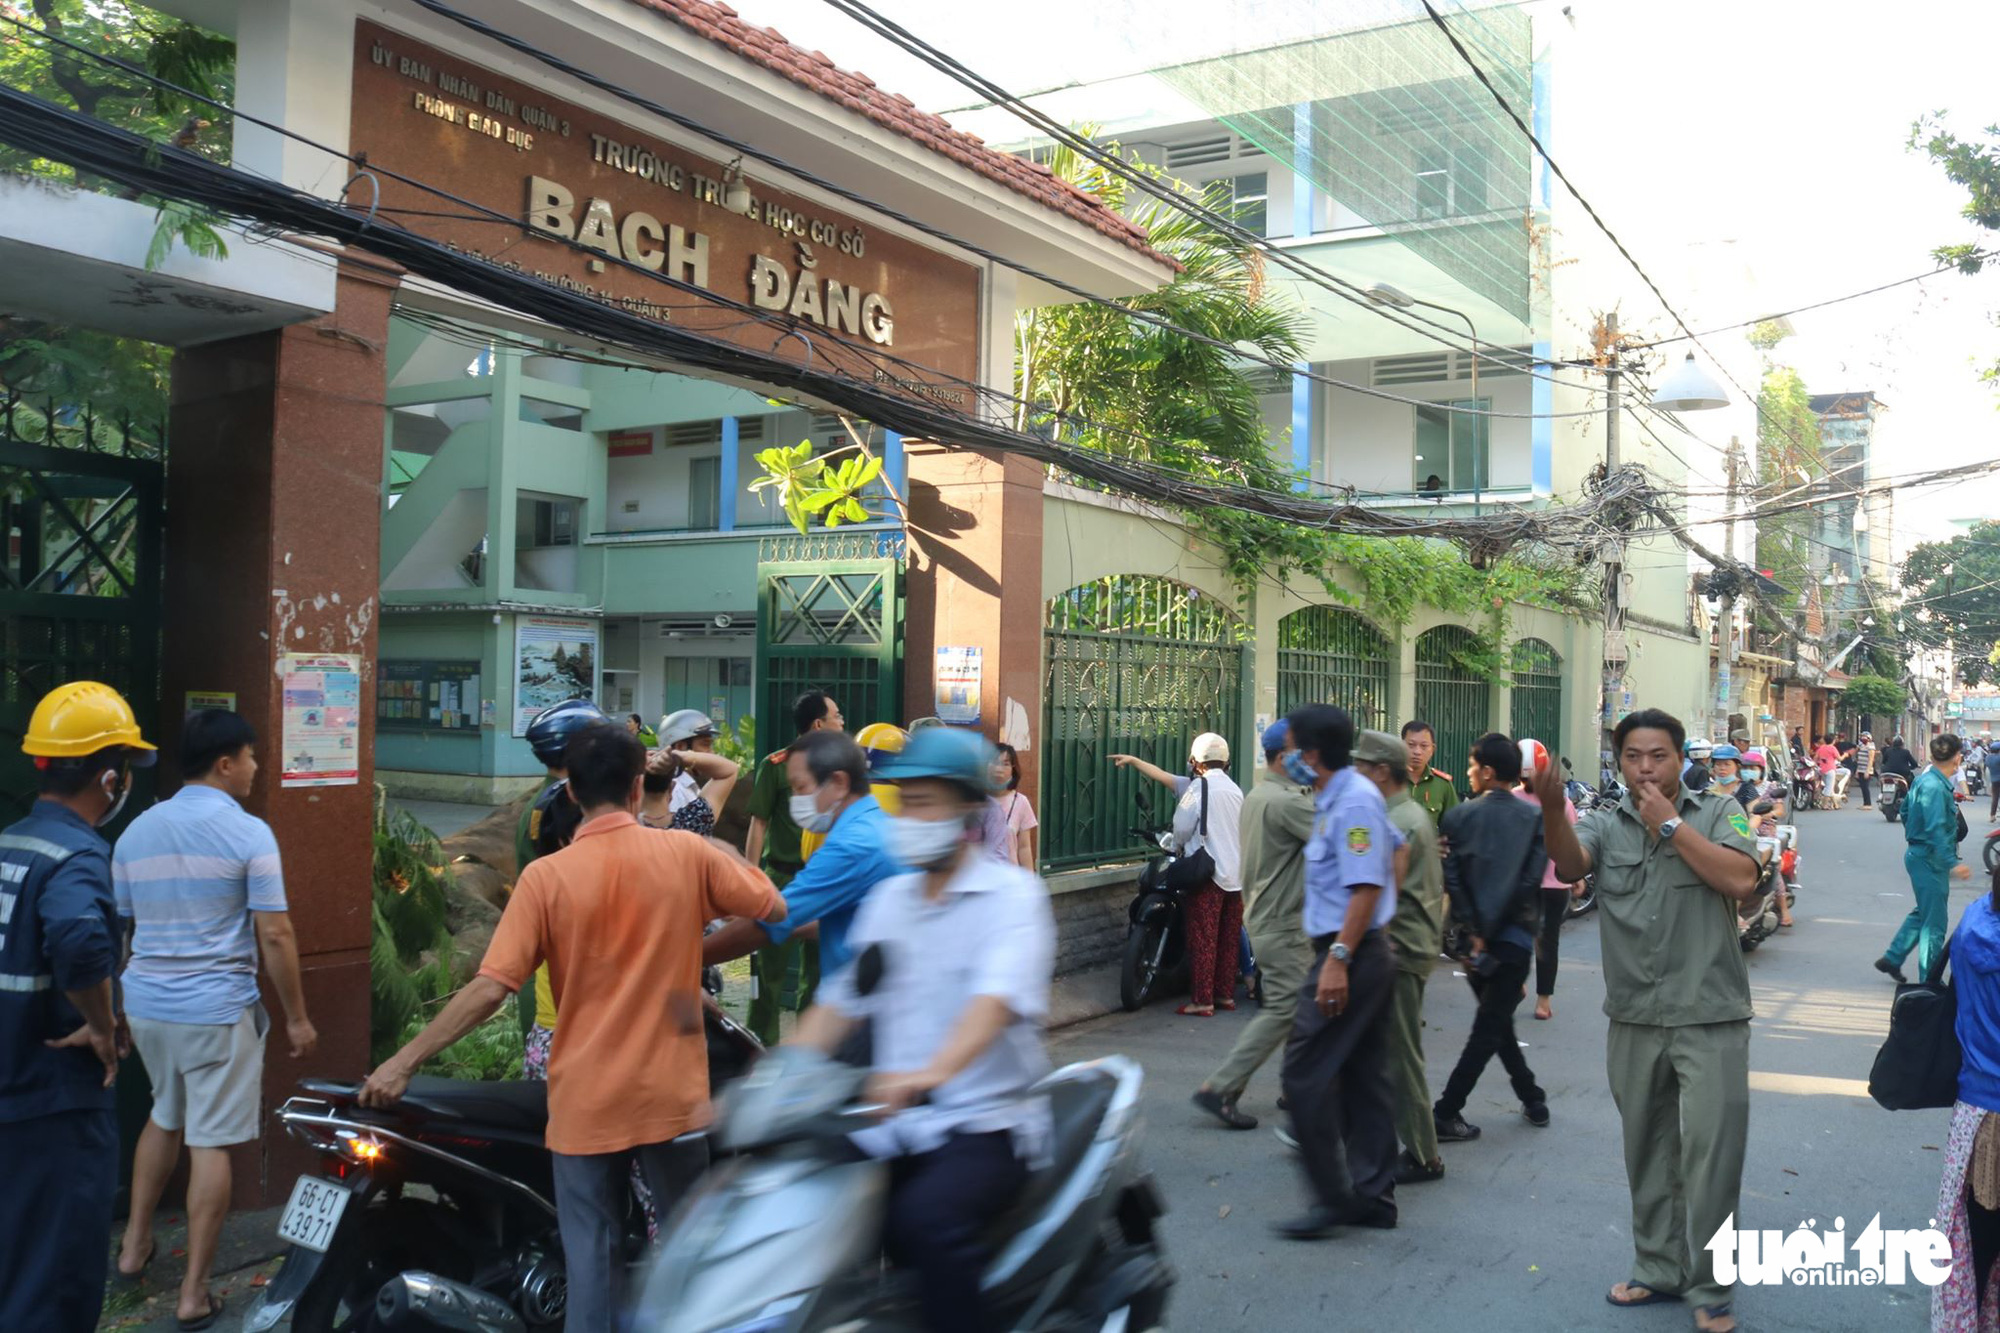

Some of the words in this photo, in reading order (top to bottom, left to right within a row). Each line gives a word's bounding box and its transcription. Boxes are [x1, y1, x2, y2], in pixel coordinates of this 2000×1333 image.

[399, 55, 431, 83] BAN
[438, 72, 479, 103] NHÂN
[486, 89, 515, 117] DÂN
[521, 104, 558, 133] QUẬN
[561, 120, 571, 137] 3
[414, 92, 464, 125] PHÒNG
[506, 126, 533, 152] DỤC
[765, 201, 806, 238] HỌC
[810, 218, 836, 248] CƠ
[840, 225, 866, 259] SỞ
[526, 175, 710, 289] BẠCH
[750, 241, 895, 347] ĐẰNG
[662, 307, 671, 321] 3
